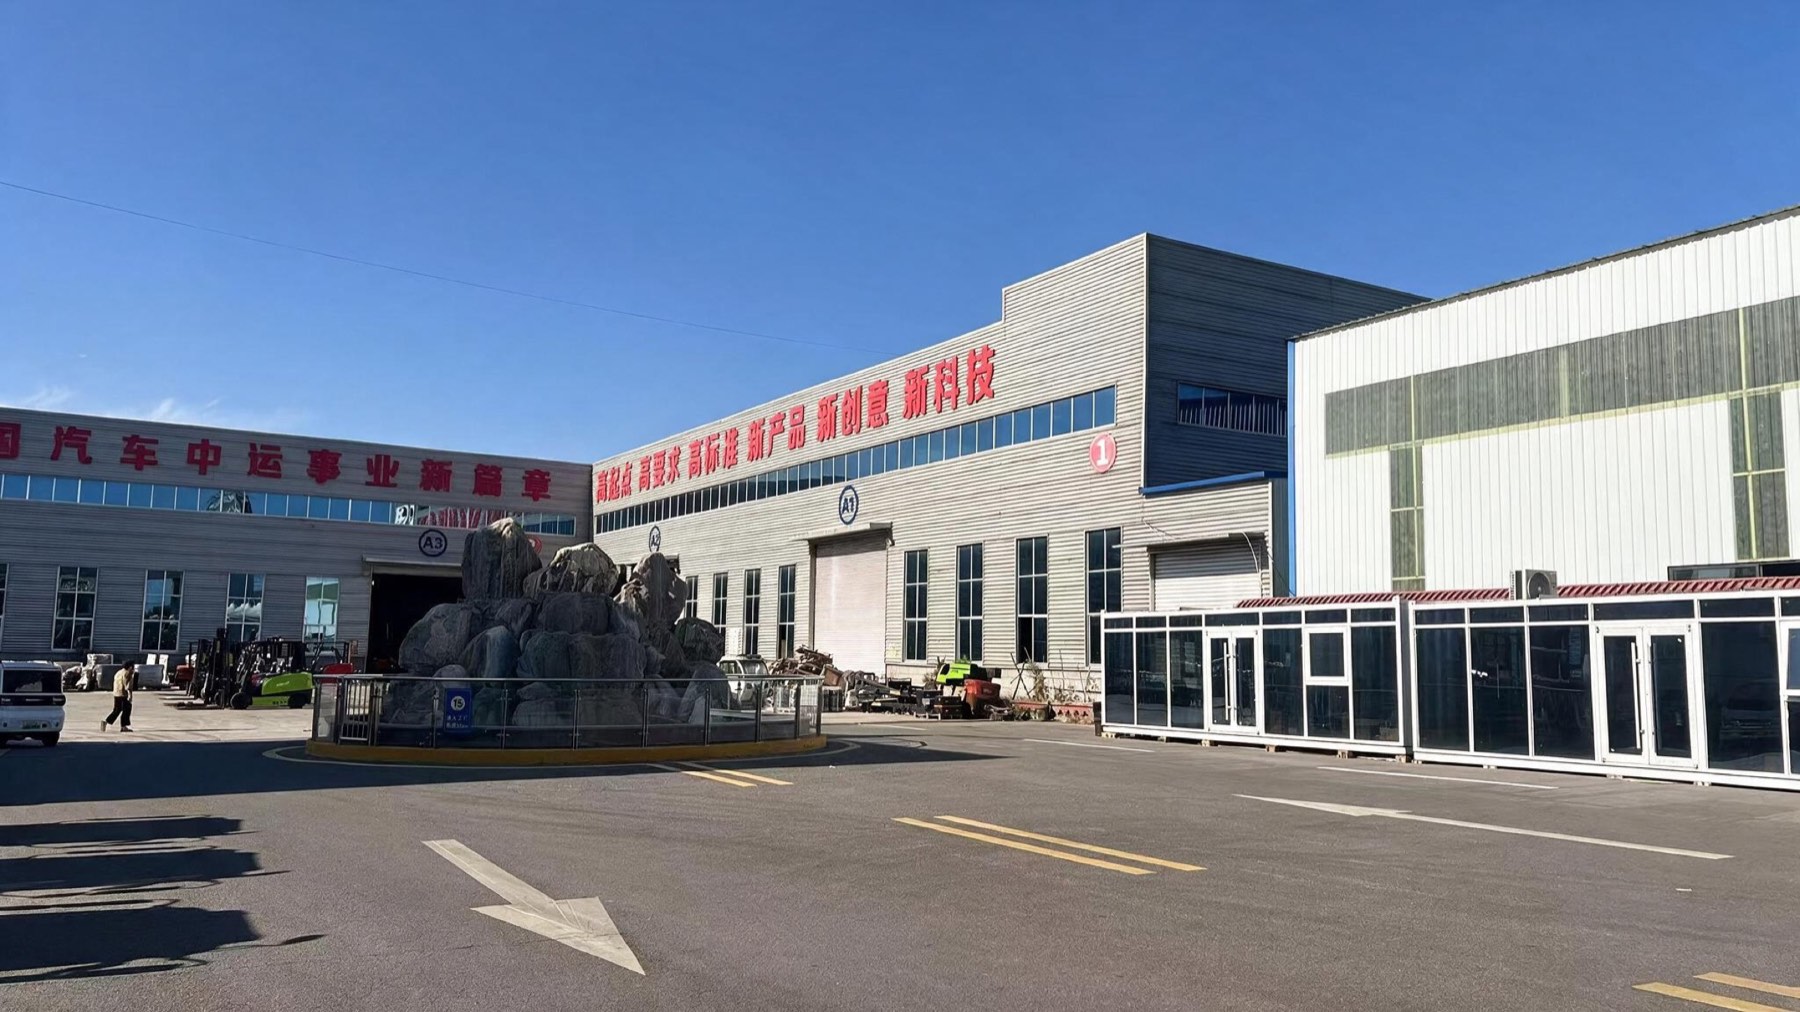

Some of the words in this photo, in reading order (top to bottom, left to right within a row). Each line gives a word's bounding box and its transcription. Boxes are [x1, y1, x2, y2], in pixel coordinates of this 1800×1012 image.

[596, 461, 632, 503] 高起点
[638, 446, 681, 492] 高要求
[688, 427, 739, 480] 高标准
[746, 404, 806, 462] 新产品
[817, 379, 889, 443] 新创意
[903, 344, 996, 420] 新科技
[1097, 439, 1109, 466] 1
[422, 536, 443, 550] A3
